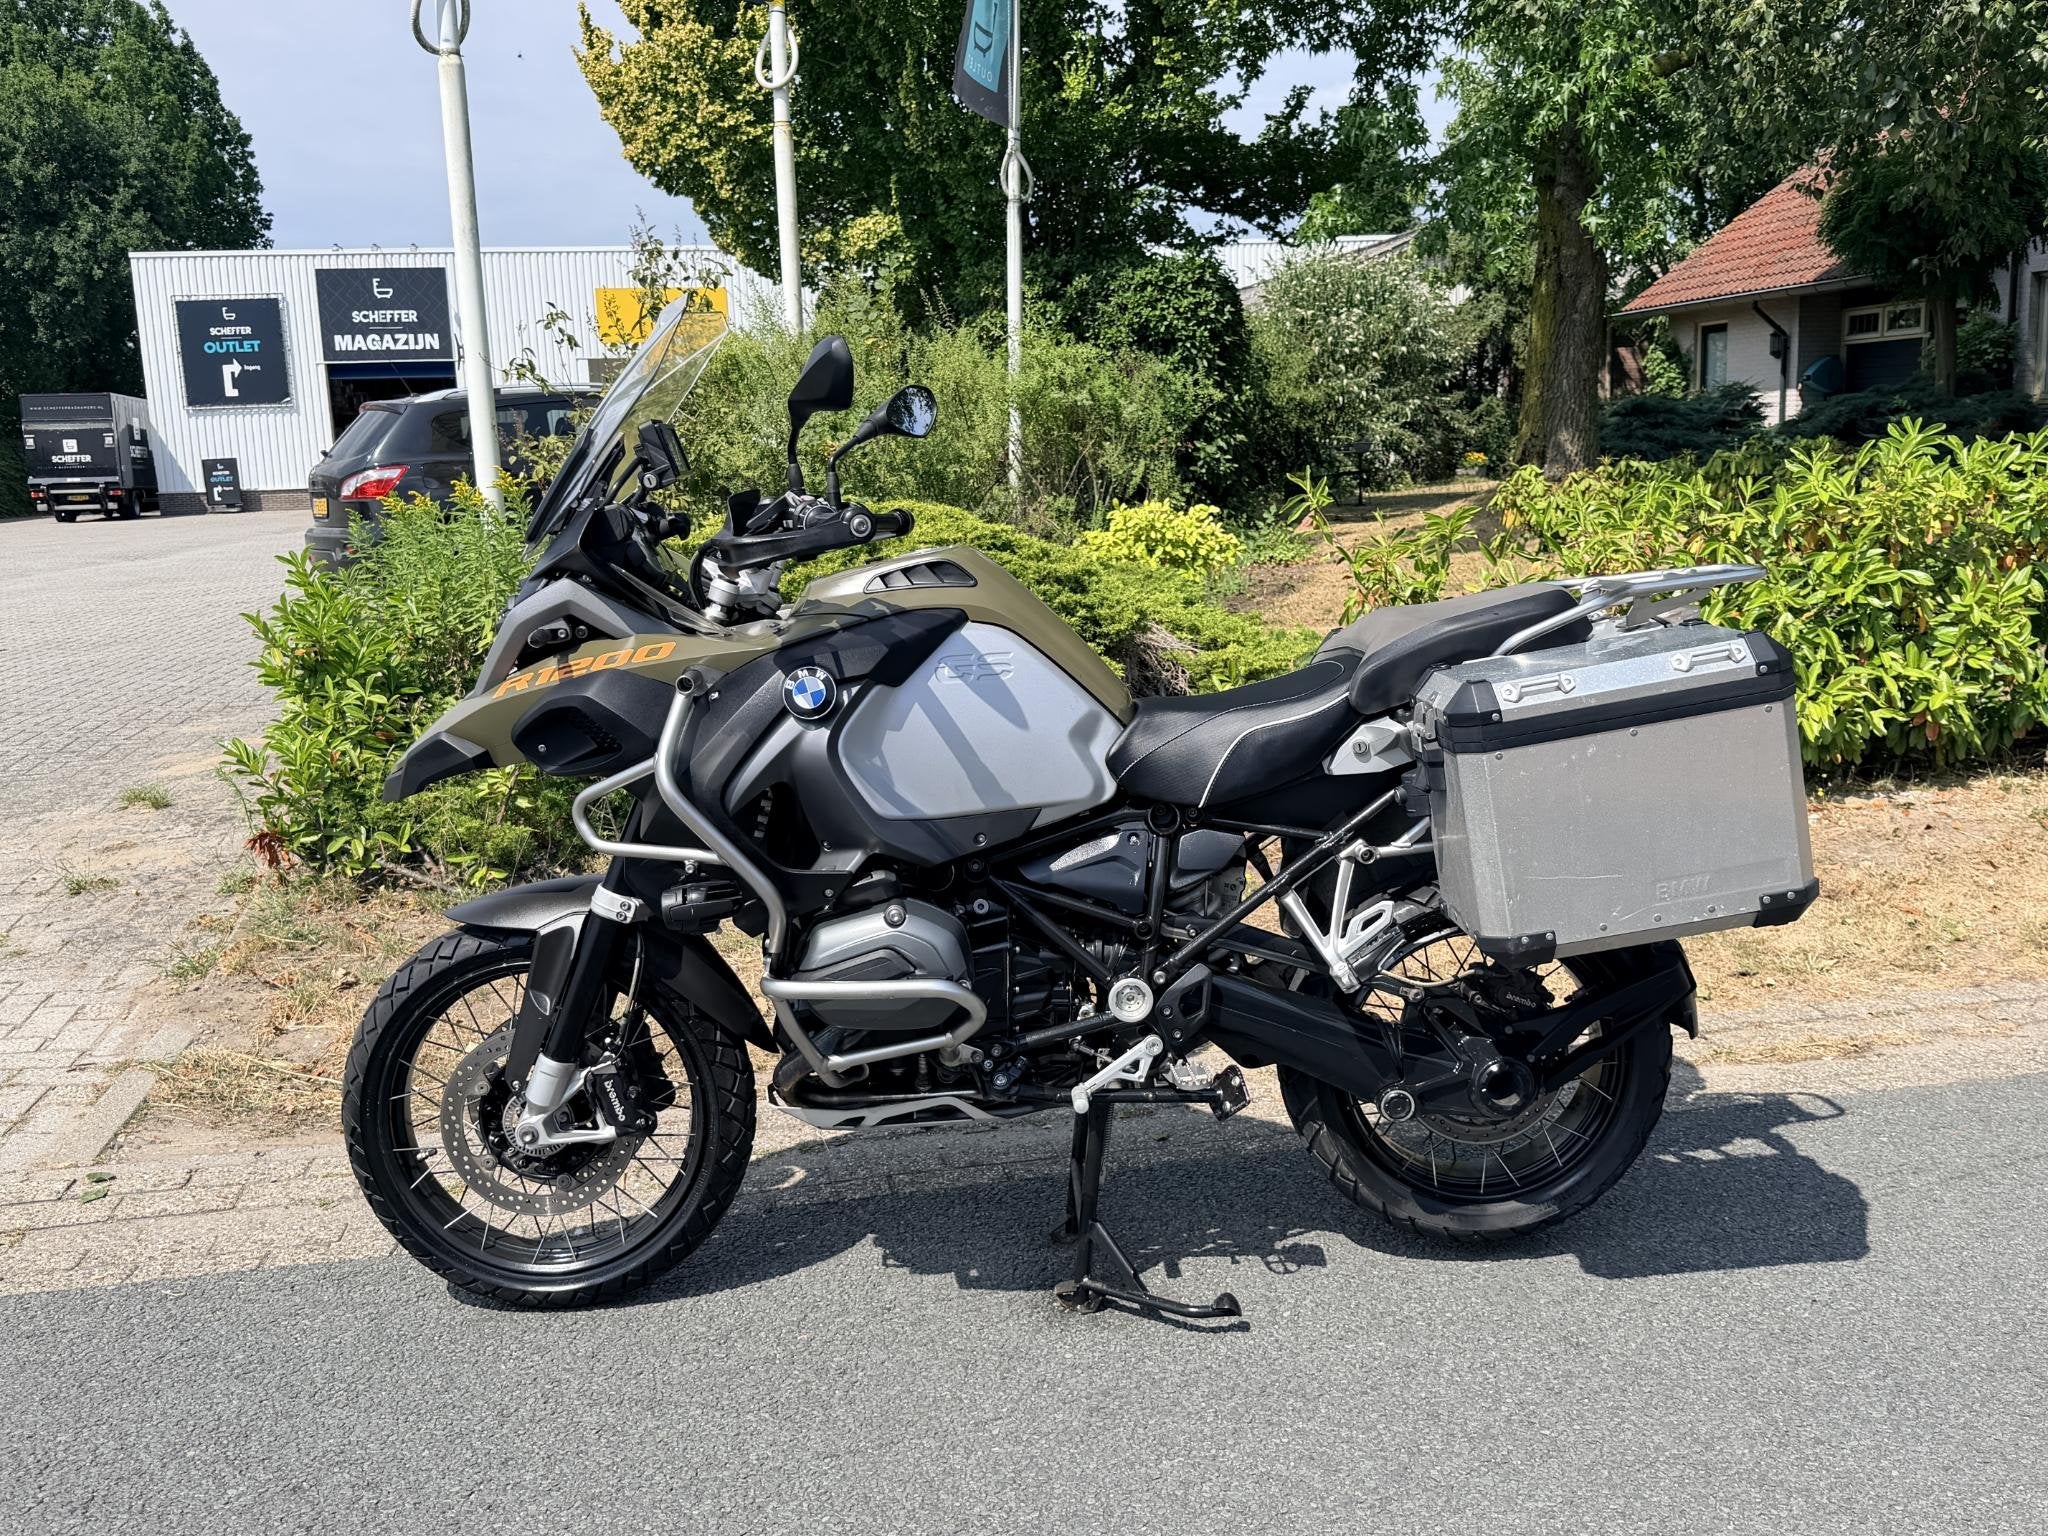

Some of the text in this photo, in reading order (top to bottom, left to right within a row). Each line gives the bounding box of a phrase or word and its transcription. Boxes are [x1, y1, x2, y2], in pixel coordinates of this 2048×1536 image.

[351, 309, 419, 323] SCHEFFER
[209, 326, 252, 336] SCHEFFER
[203, 340, 261, 354] OUTLET
[333, 333, 440, 351] MAGAZIJN
[51, 454, 92, 463] SCHEFFER
[492, 641, 677, 699] R1200
[934, 652, 1014, 684] GS
[784, 668, 827, 690] BMW
[603, 1079, 626, 1122] brembo
